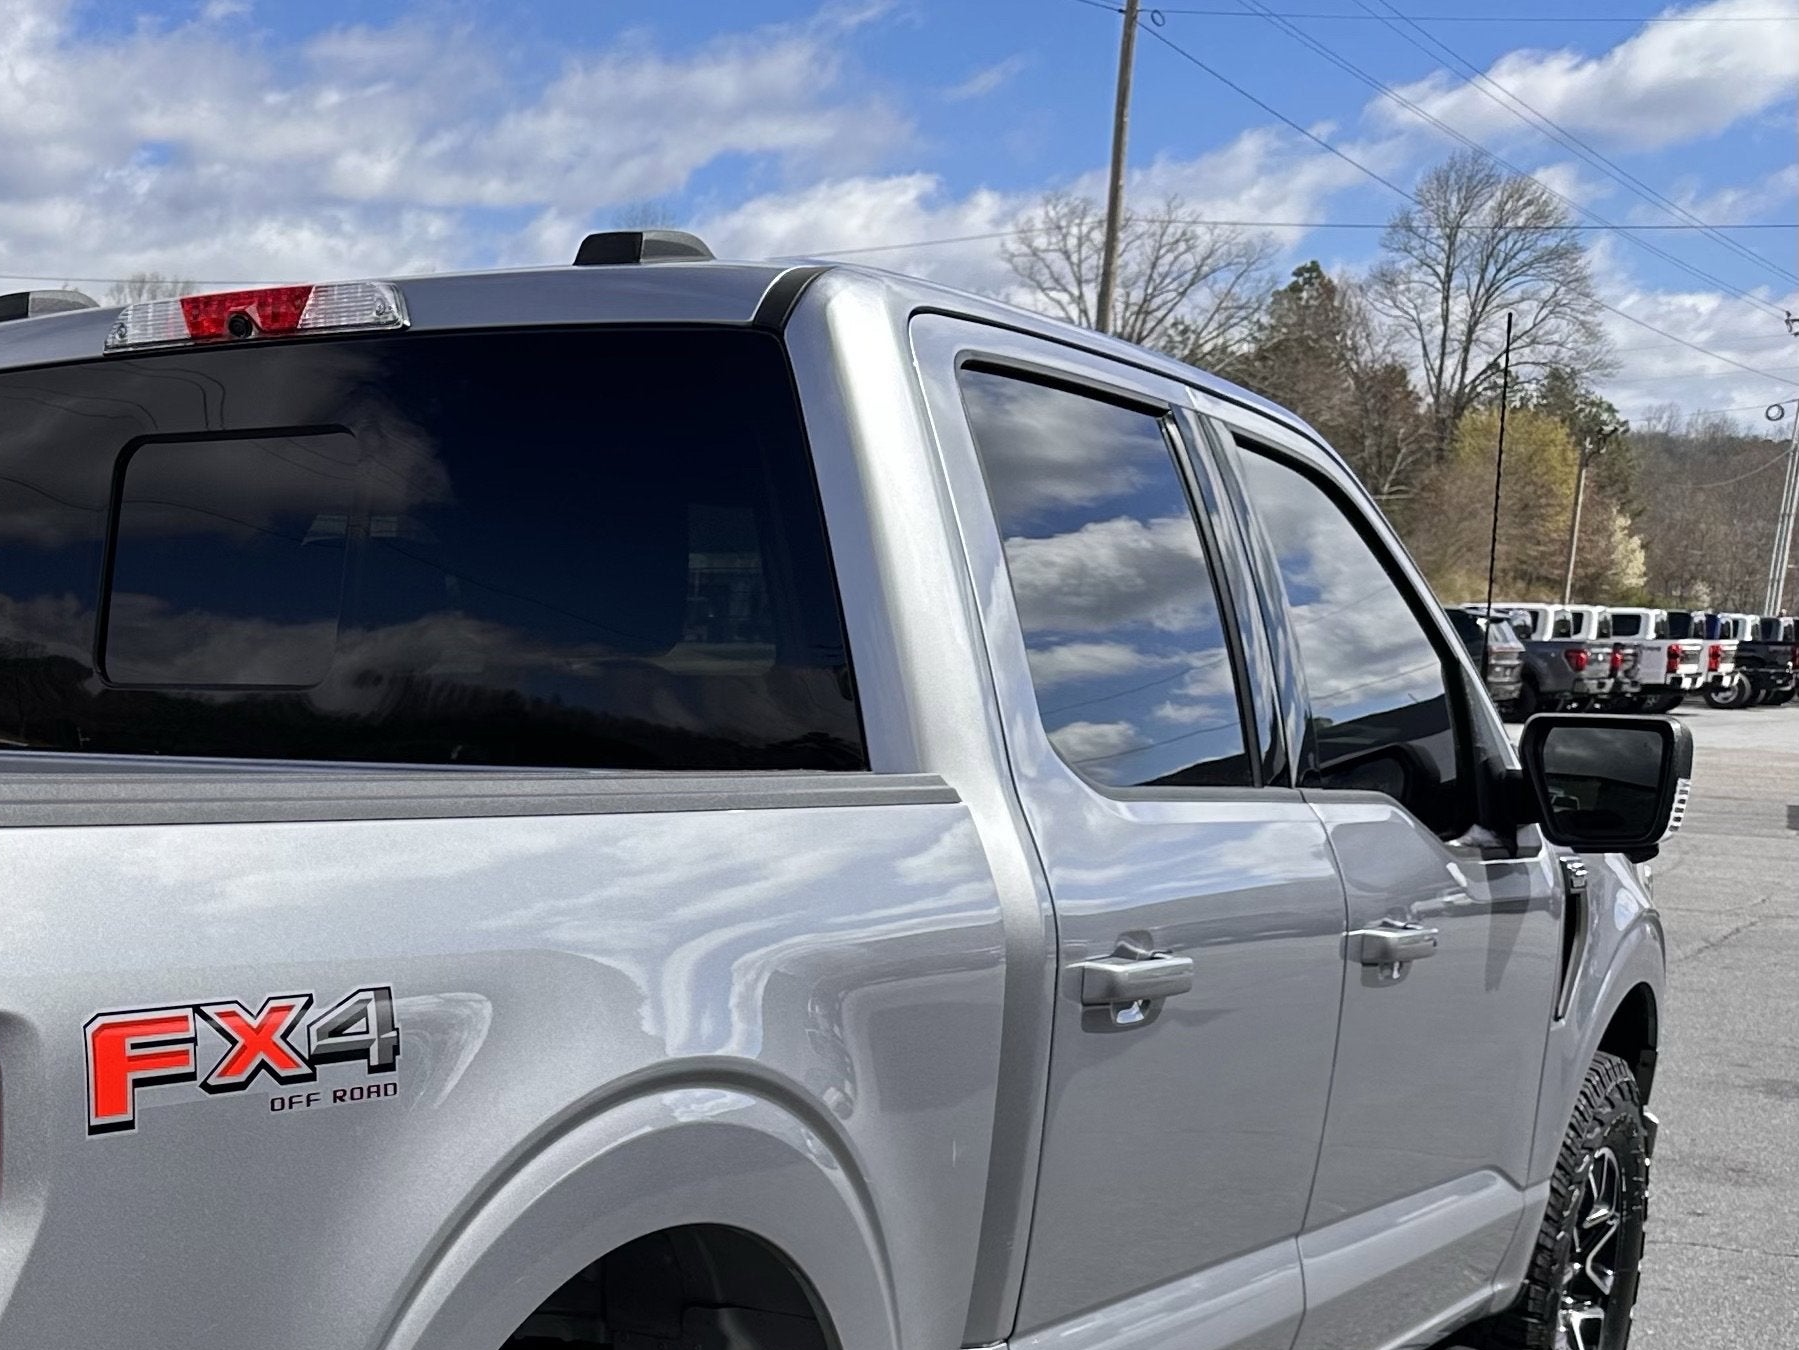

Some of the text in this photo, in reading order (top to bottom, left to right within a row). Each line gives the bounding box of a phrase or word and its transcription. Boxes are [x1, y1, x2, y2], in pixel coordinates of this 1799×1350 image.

[83, 987, 400, 1136] FX4
[269, 1082, 399, 1113] OFF ROAD
